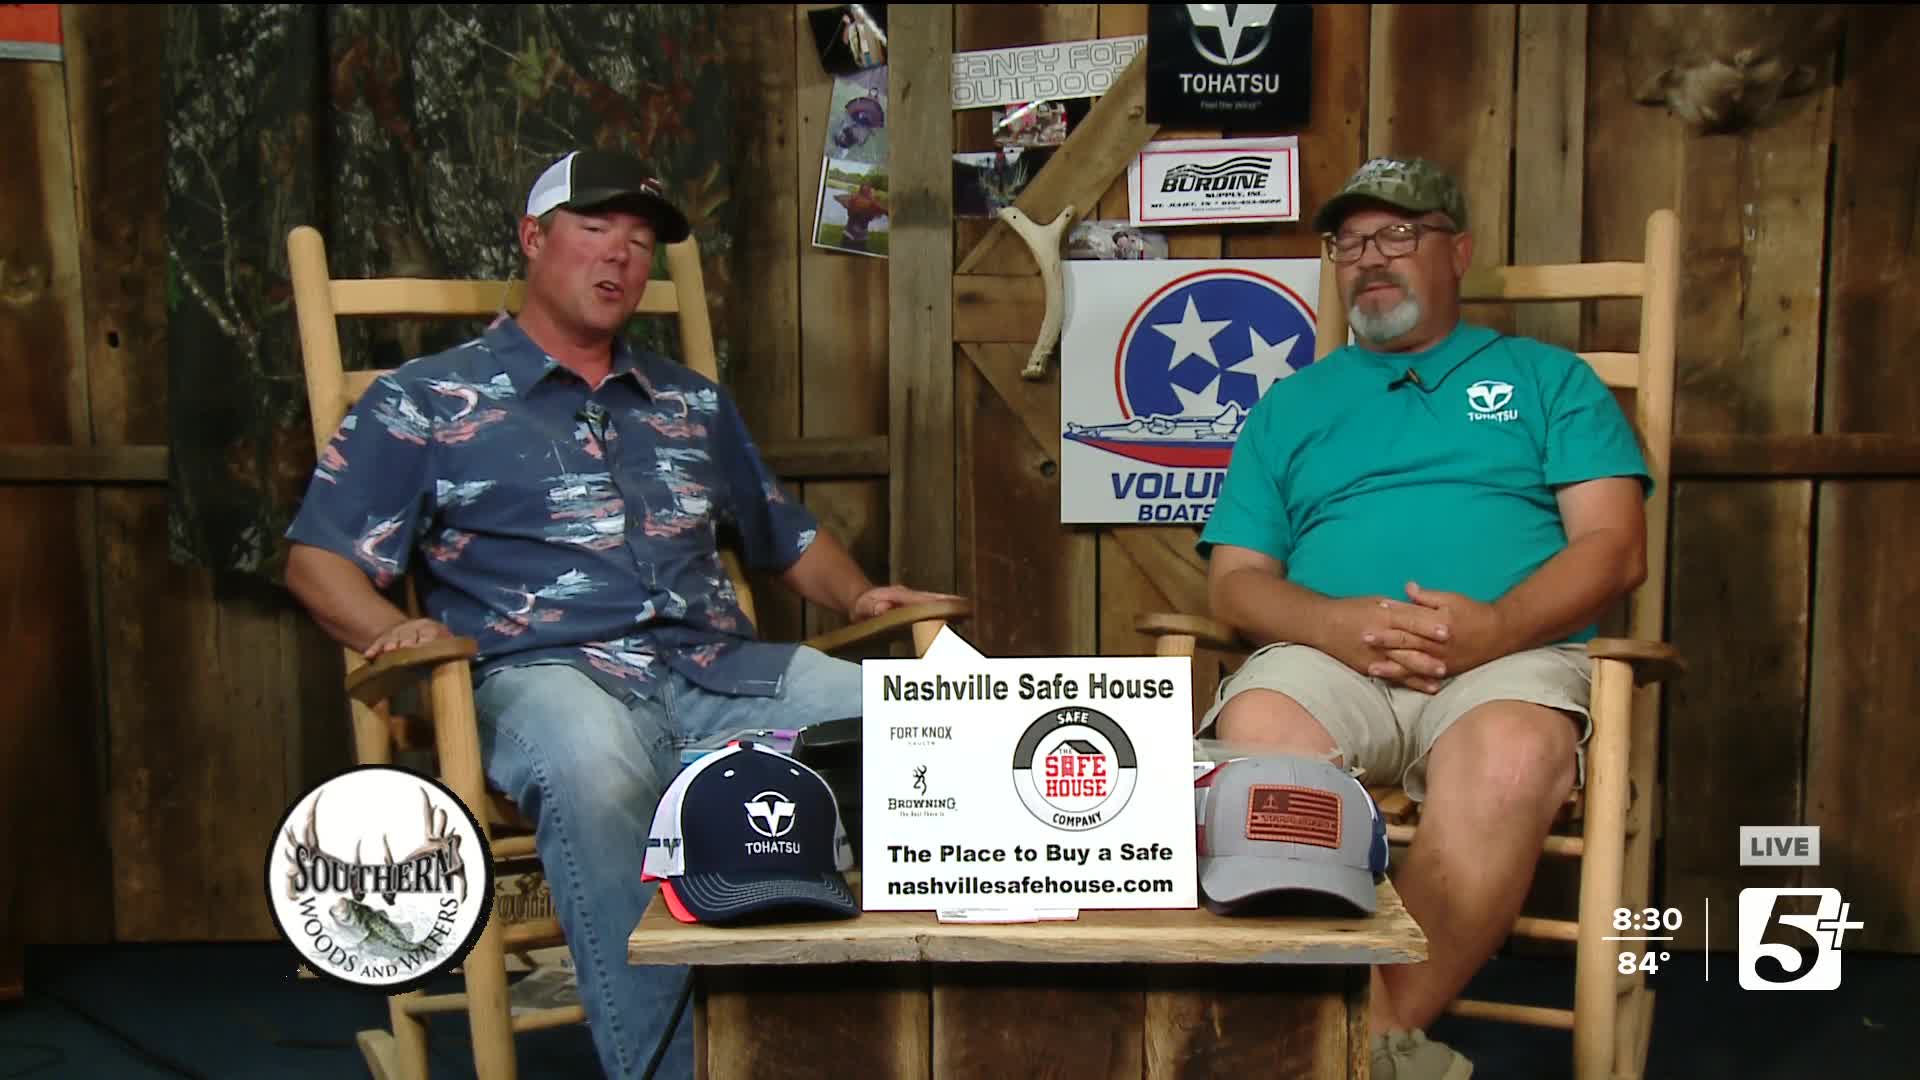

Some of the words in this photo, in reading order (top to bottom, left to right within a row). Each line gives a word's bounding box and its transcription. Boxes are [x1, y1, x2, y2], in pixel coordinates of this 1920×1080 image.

[952, 65, 1127, 106] OUTDOO
[1179, 73, 1281, 94] TOHATSU
[1161, 172, 1270, 193] BURDINE
[883, 674, 1009, 701] Nashville
[1018, 672, 1079, 700] Safe
[1088, 672, 1174, 699] House
[1057, 711, 1089, 724] SAFE
[890, 726, 919, 741] FORT
[921, 726, 952, 740] KNOX
[1045, 779, 1107, 797] HOUSE
[888, 797, 956, 810] BROWNING
[1052, 811, 1102, 827] COMPANY
[745, 841, 801, 855] TOHATSU
[887, 845, 932, 863] The
[940, 845, 1006, 862] Place
[1015, 845, 1037, 862] to
[1046, 844, 1090, 865] Buy
[1098, 848, 1112, 861] a
[1120, 843, 1173, 861] Safe
[887, 876, 1174, 895] nashvillesafehouse.com
